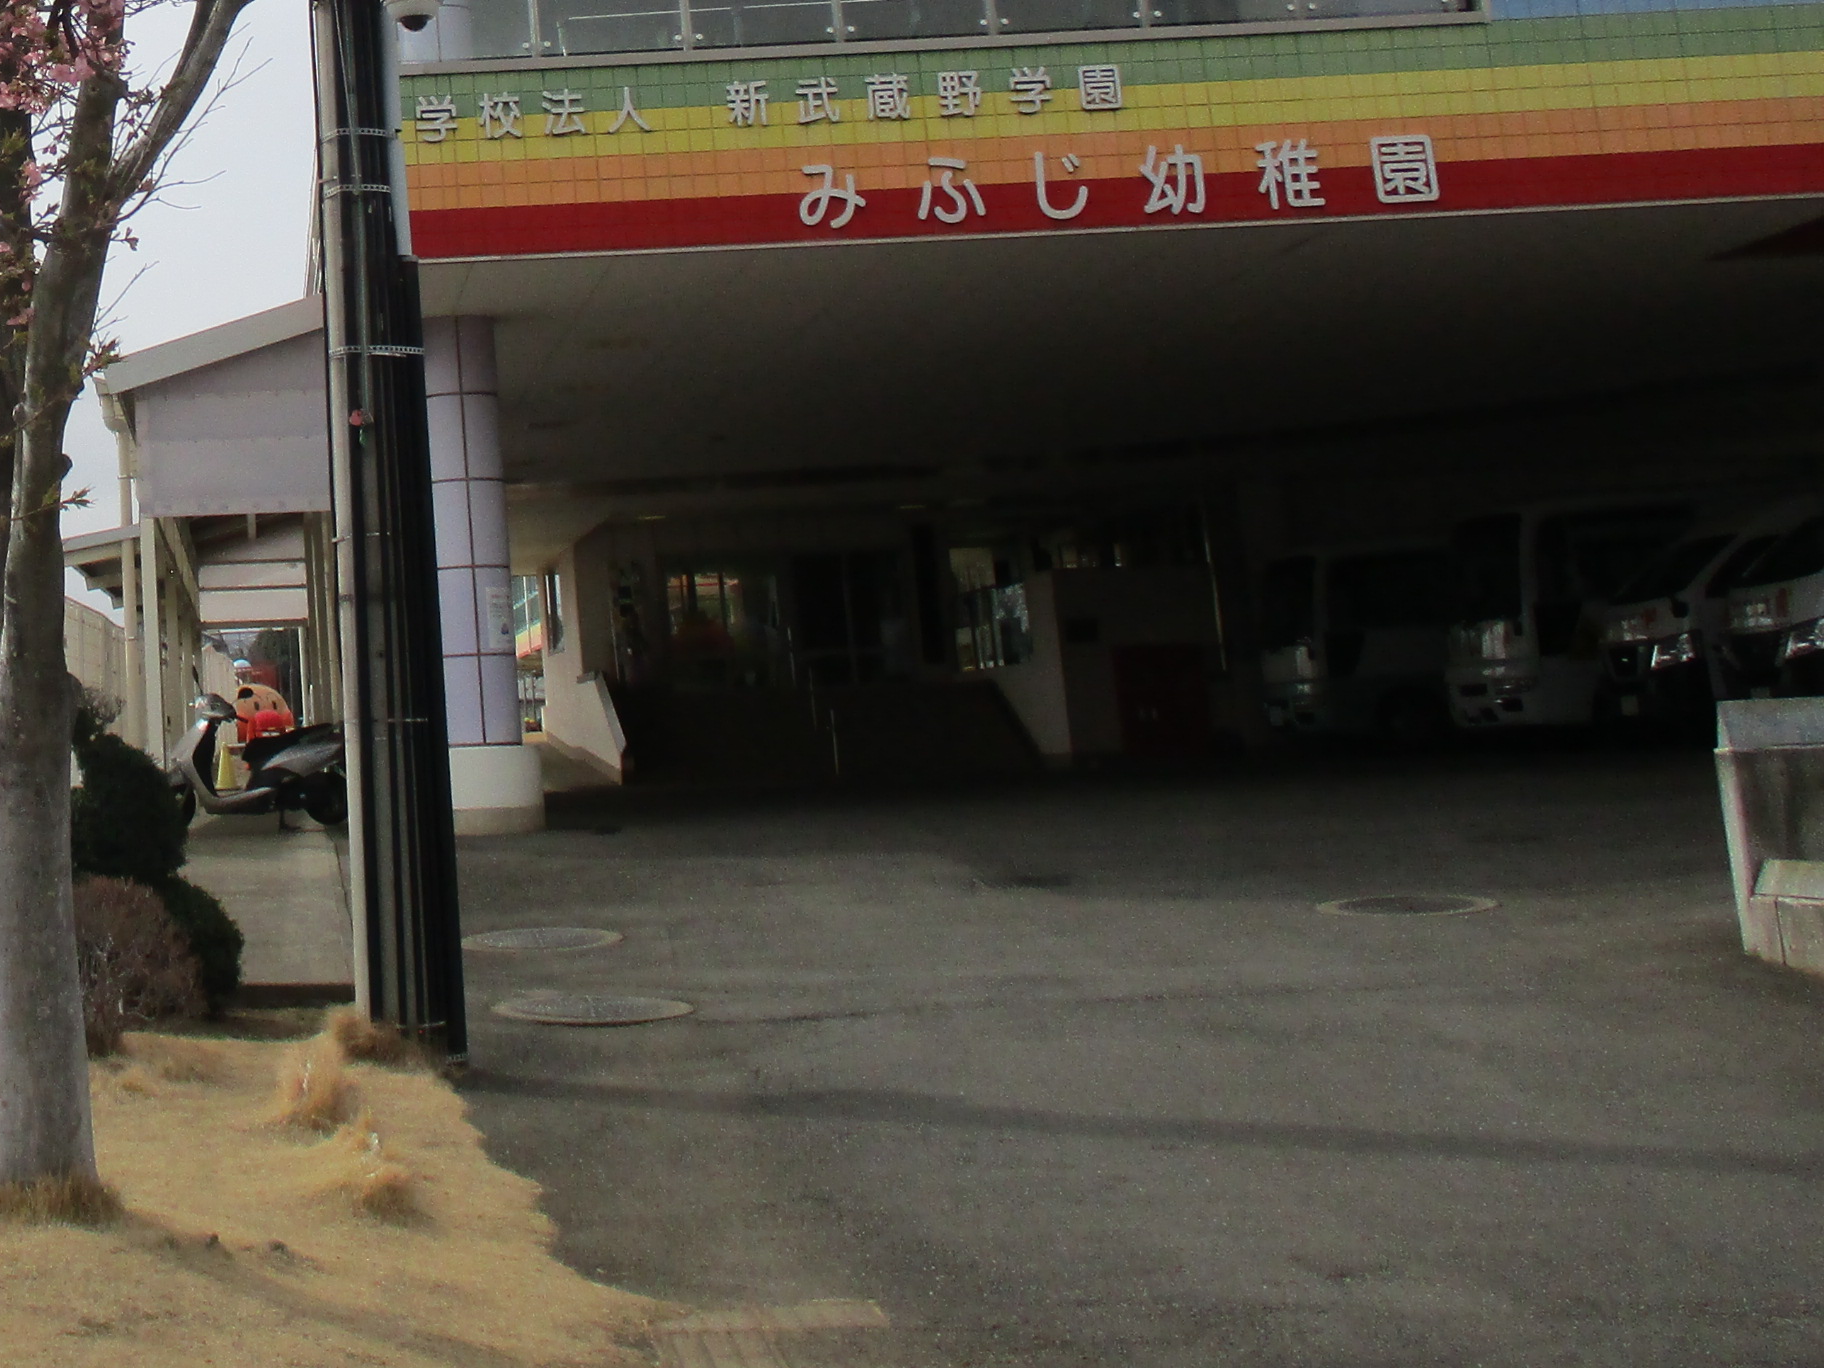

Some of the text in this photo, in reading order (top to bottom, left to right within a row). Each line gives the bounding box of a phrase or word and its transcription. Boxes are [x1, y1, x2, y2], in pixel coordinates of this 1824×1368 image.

[414, 64, 1123, 143] 学校法人 新武蔵野学園
[798, 134, 1441, 229] みふじ幼稚園
